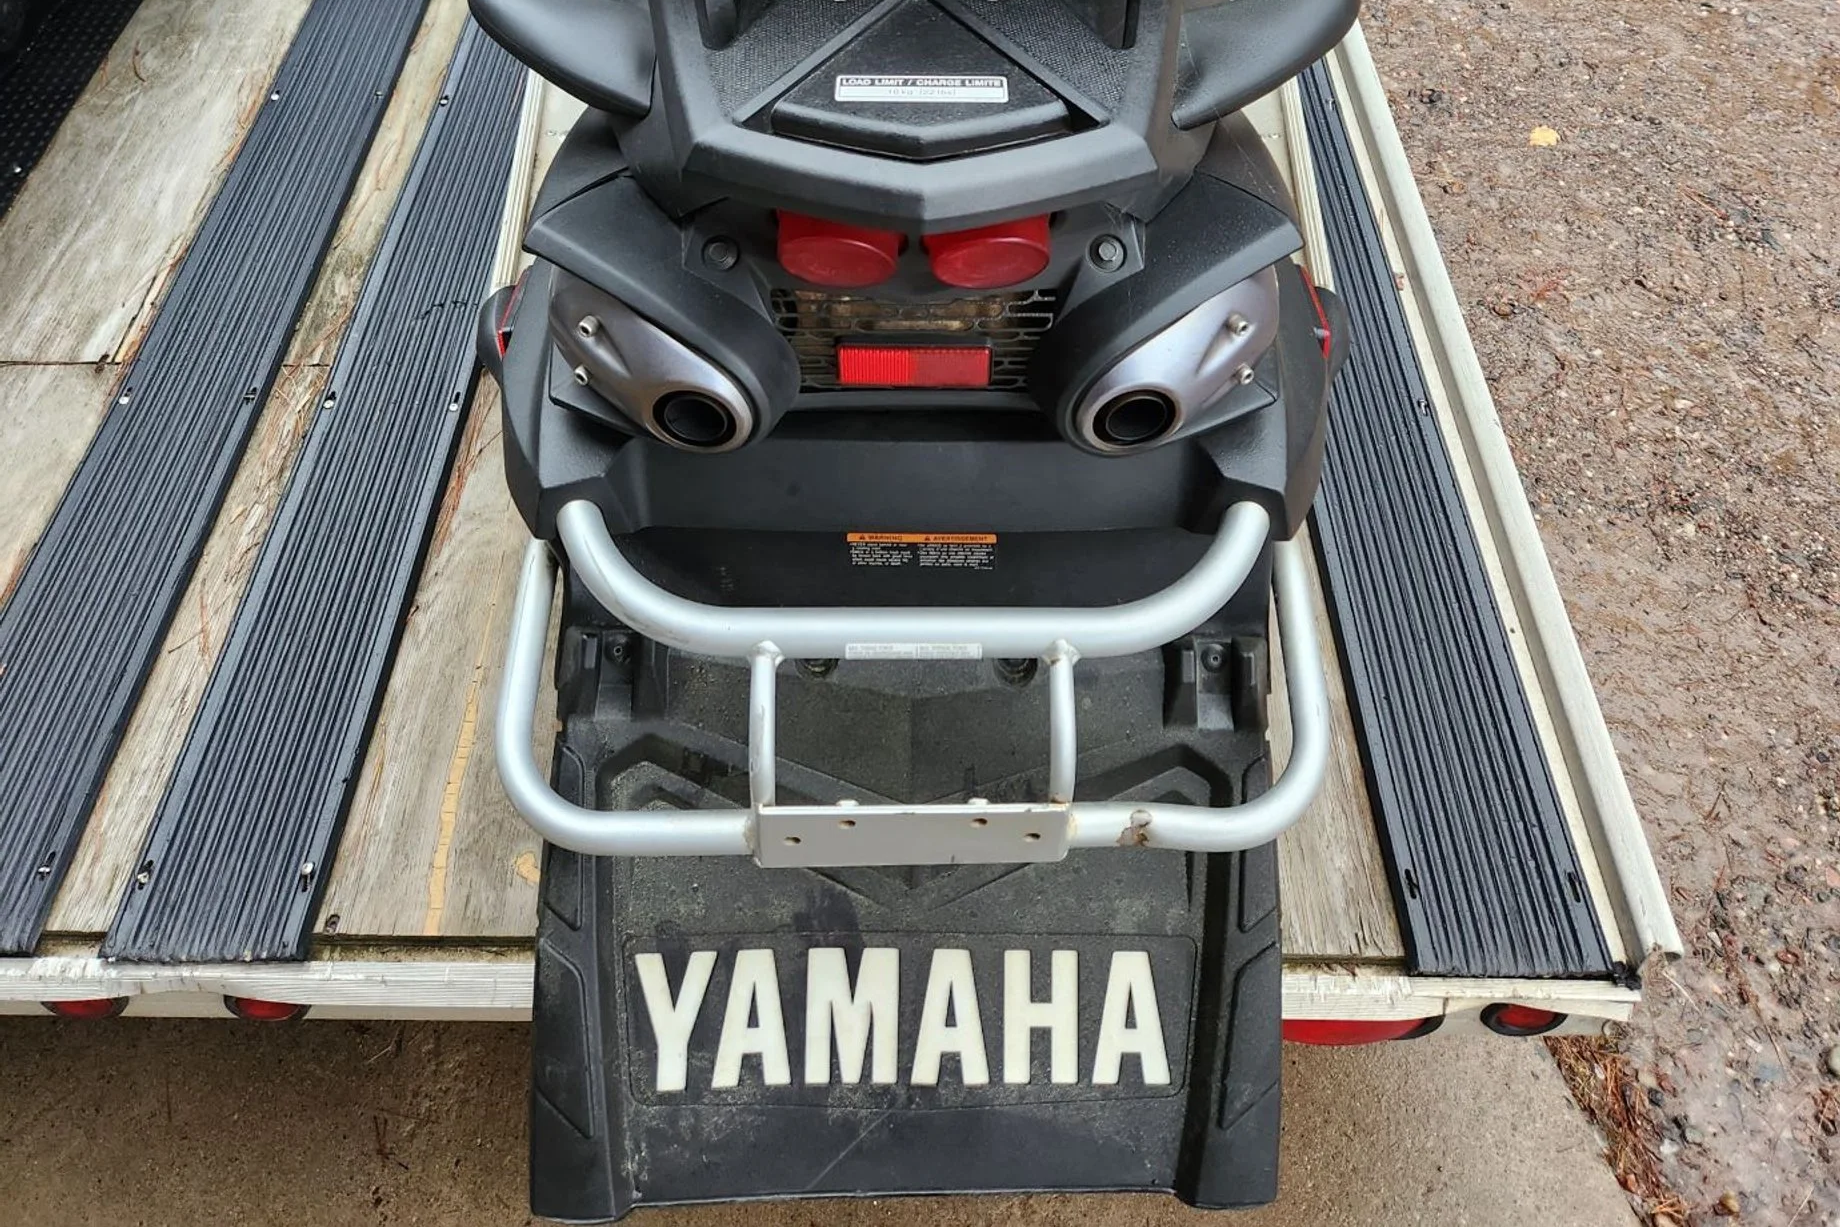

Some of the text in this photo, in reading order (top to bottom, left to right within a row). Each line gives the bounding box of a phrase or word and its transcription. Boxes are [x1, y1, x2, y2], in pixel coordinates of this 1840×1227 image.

[842, 78, 871, 86] LOAD
[874, 78, 904, 86] LIMIT
[916, 78, 962, 87] CHARGE
[965, 79, 1001, 87] LIMITE
[635, 947, 1171, 1092] YAMAHA
